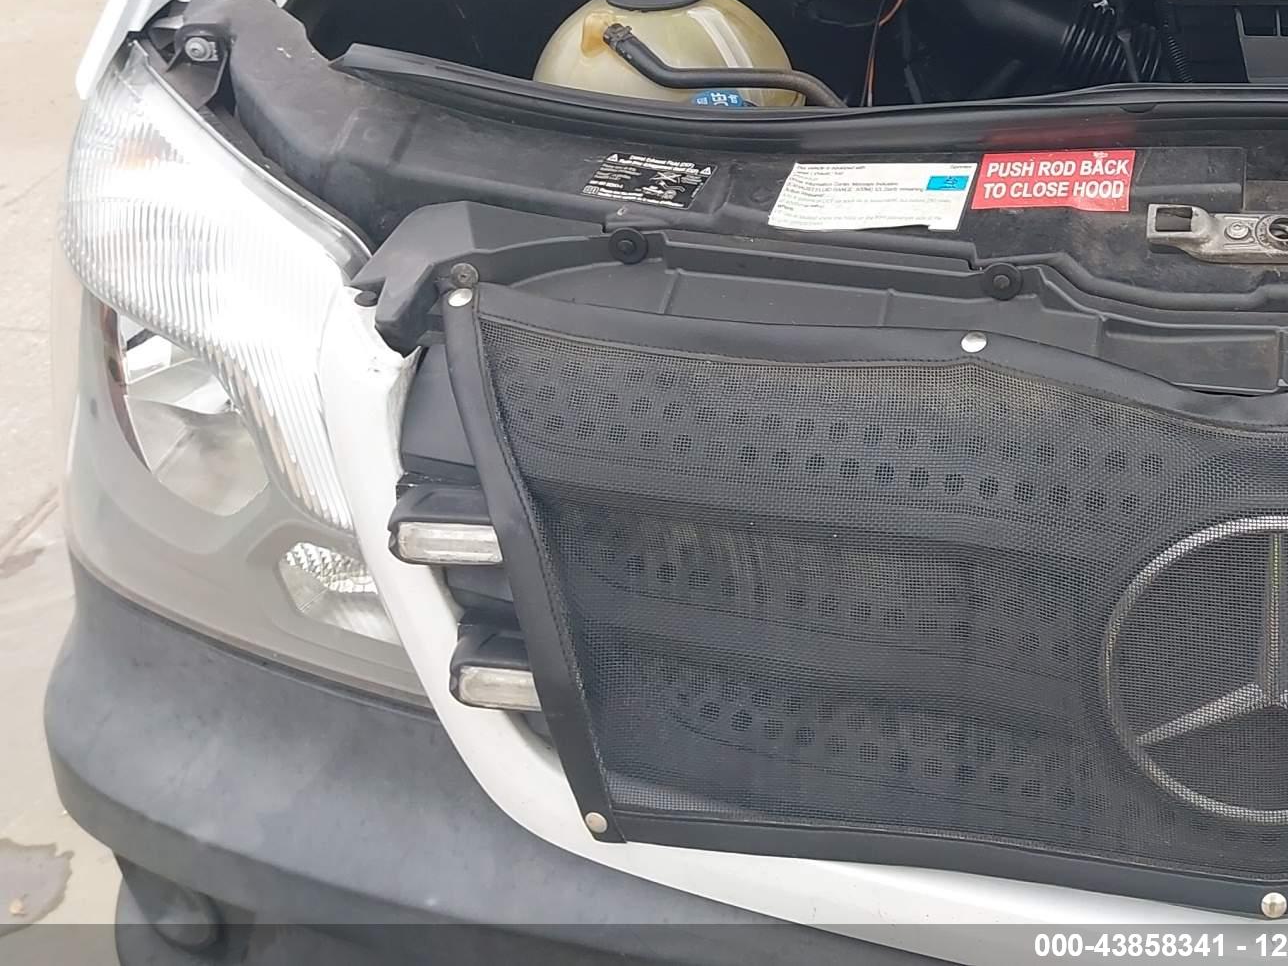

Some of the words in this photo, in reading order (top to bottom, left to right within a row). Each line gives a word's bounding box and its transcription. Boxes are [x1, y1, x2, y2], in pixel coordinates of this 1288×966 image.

[986, 161, 1035, 178] PUSH
[1037, 160, 1077, 176] ROD
[1079, 159, 1130, 177] BACK
[983, 182, 1007, 199] TO
[1009, 181, 1070, 198] CLOSE
[1073, 180, 1125, 199] HOOD
